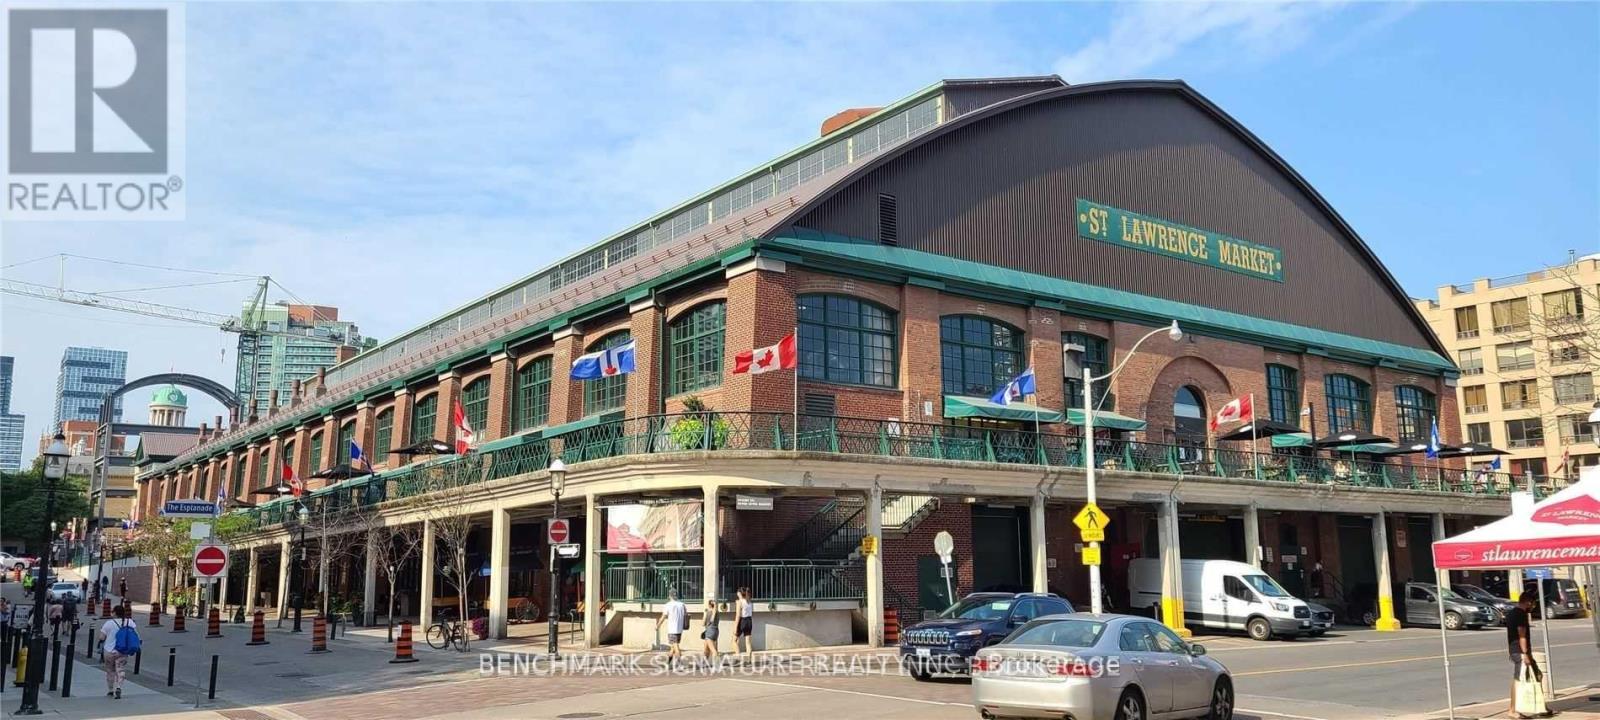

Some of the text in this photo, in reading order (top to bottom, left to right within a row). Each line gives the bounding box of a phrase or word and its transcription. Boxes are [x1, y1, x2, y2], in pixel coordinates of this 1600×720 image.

[1120, 215, 1208, 260] LAWRENCE
[1217, 239, 1275, 275] MARKET
[167, 503, 213, 513] The Esplanade
